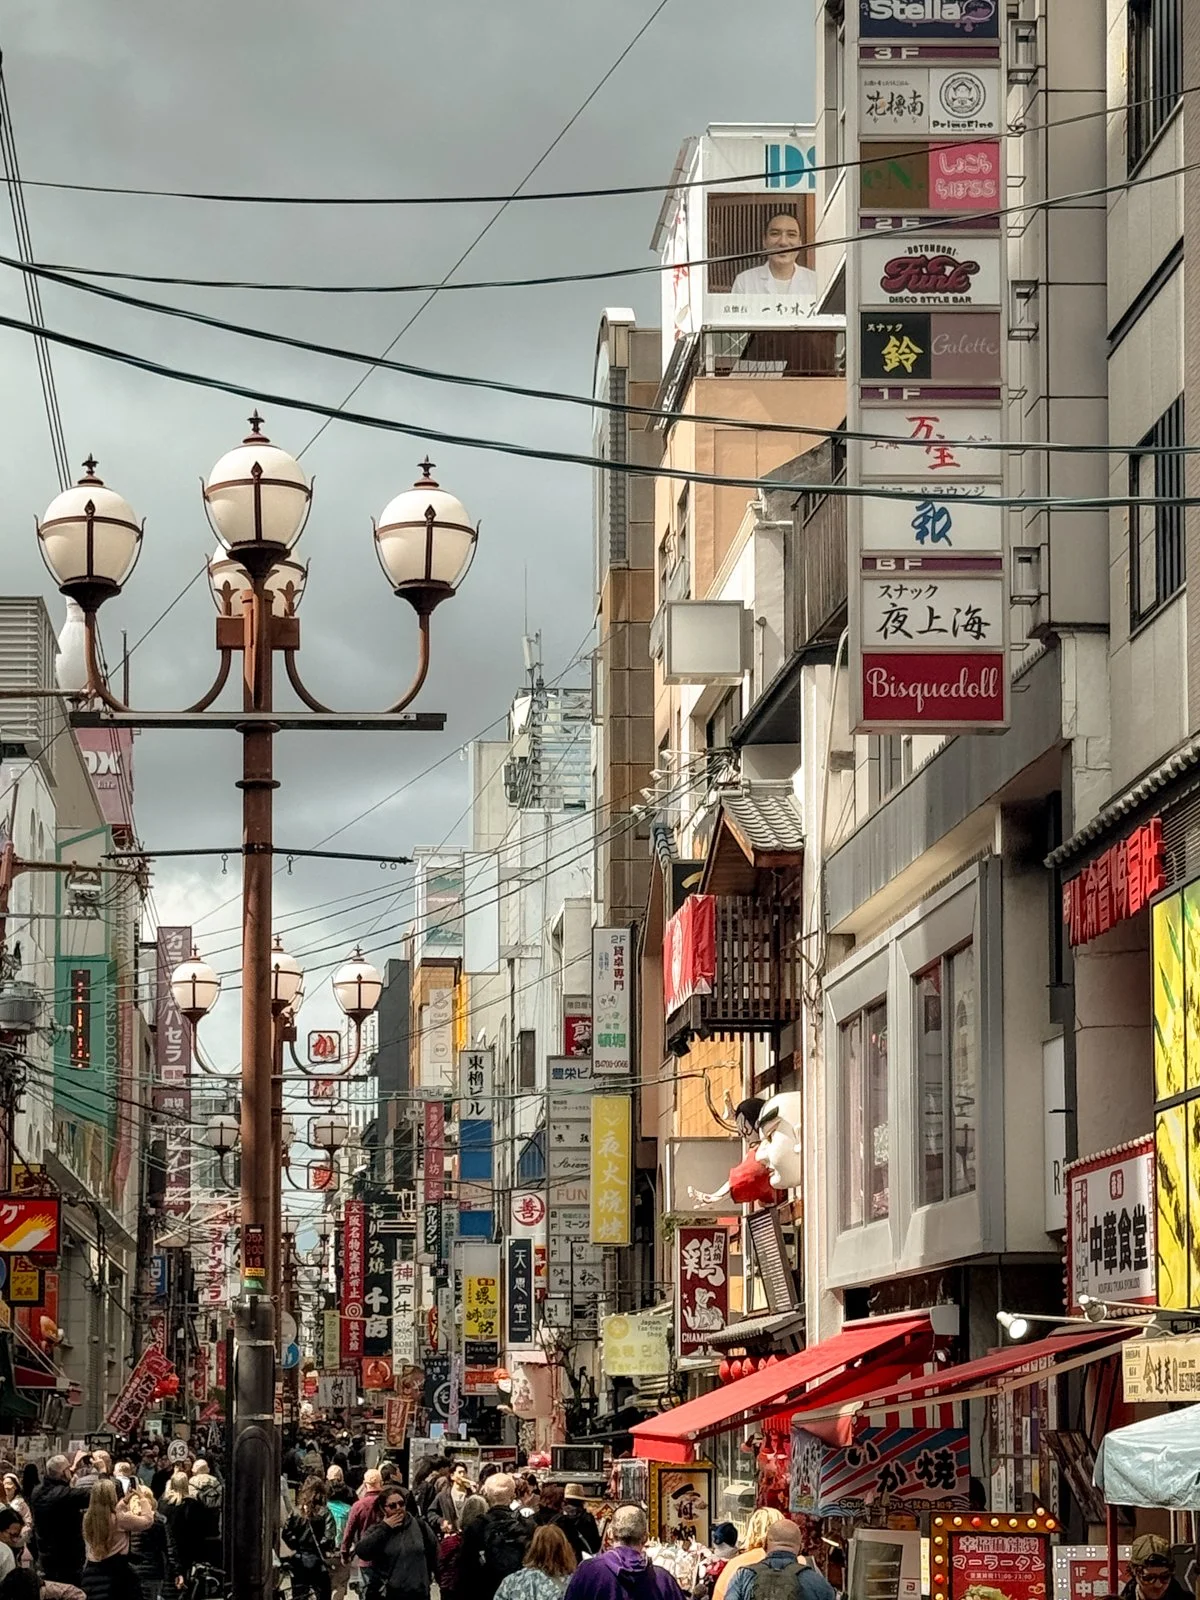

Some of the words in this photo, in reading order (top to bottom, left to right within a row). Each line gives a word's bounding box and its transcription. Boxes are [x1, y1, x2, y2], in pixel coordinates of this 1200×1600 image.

[868, 0, 962, 20] Stella
[889, 296, 918, 304] DISCO
[920, 296, 950, 304] STYLE
[952, 296, 972, 304] BAR
[866, 323, 904, 333] スナック
[881, 336, 924, 374] 鈴
[878, 583, 939, 600] スナック
[876, 602, 991, 641] 夜上海
[866, 666, 999, 713] Bisquedoll
[394, 1264, 414, 1318] 神戸牛
[364, 1286, 389, 1339] 千房
[846, 1439, 957, 1493] いか焼
[952, 1554, 1046, 1572] マーラータン
